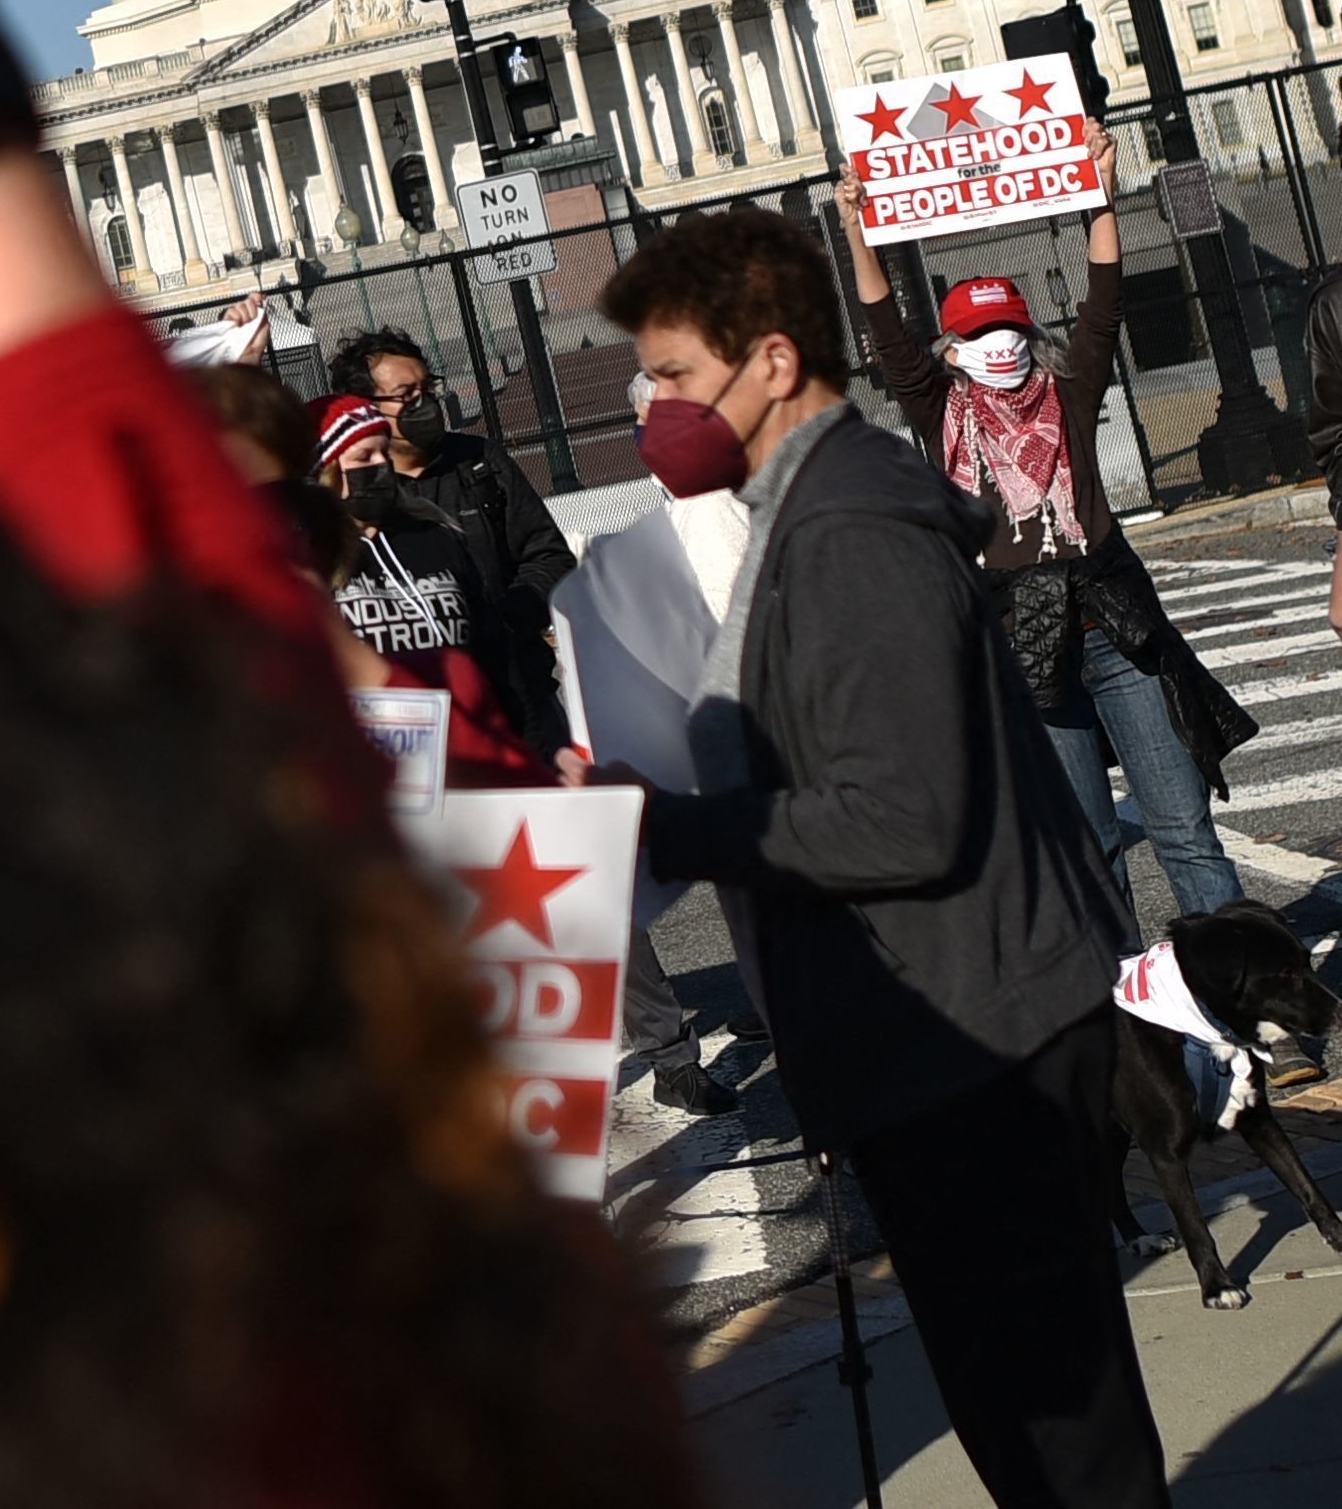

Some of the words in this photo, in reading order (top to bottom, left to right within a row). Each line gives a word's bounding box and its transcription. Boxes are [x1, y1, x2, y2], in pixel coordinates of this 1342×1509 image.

[866, 119, 1072, 180] STATEHOOD
[957, 165, 978, 179] for
[979, 162, 1002, 176] the
[480, 184, 518, 209] NO
[873, 181, 993, 225] PEOPLE
[994, 172, 1036, 205] OF
[1038, 164, 1083, 198] DC
[480, 207, 530, 231] TURN
[496, 252, 533, 271] RED
